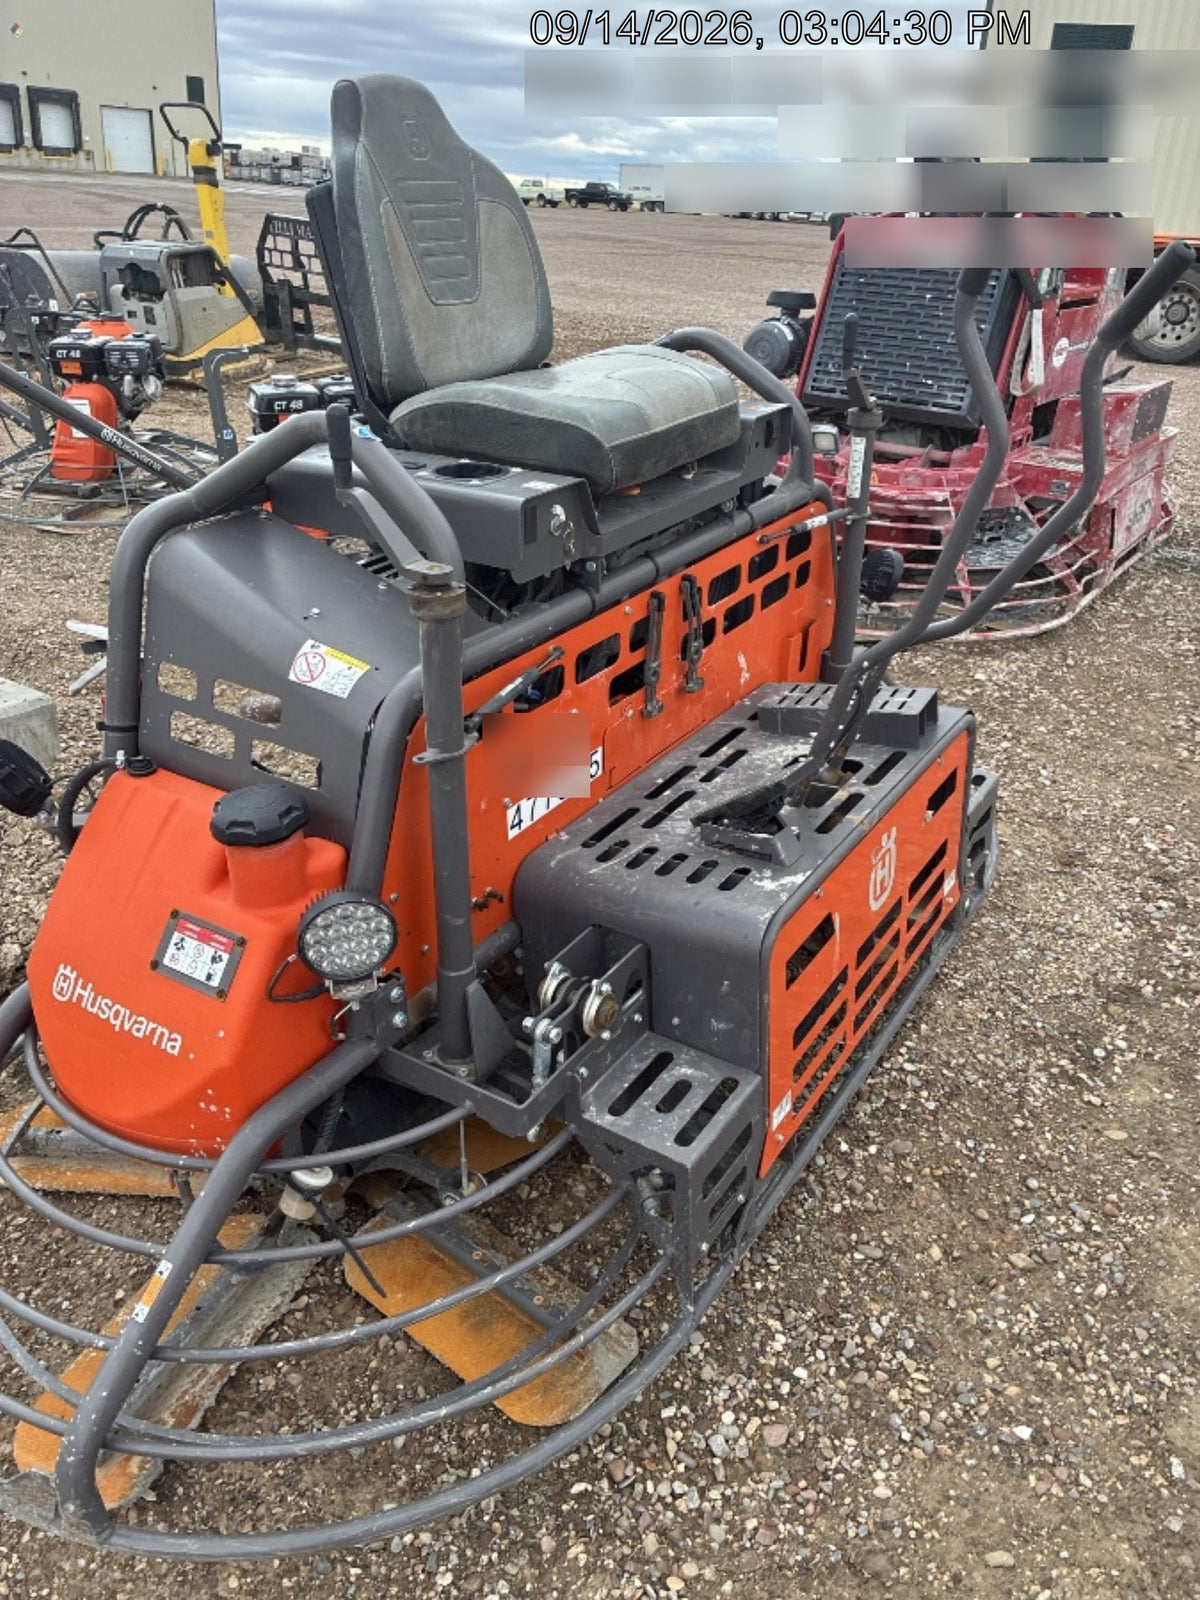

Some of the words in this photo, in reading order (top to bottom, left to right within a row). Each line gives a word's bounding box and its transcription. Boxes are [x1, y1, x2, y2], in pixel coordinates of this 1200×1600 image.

[56, 350, 68, 358] CT
[274, 401, 287, 410] CT
[289, 400, 303, 410] 48
[72, 978, 182, 1056] Husqvarna
